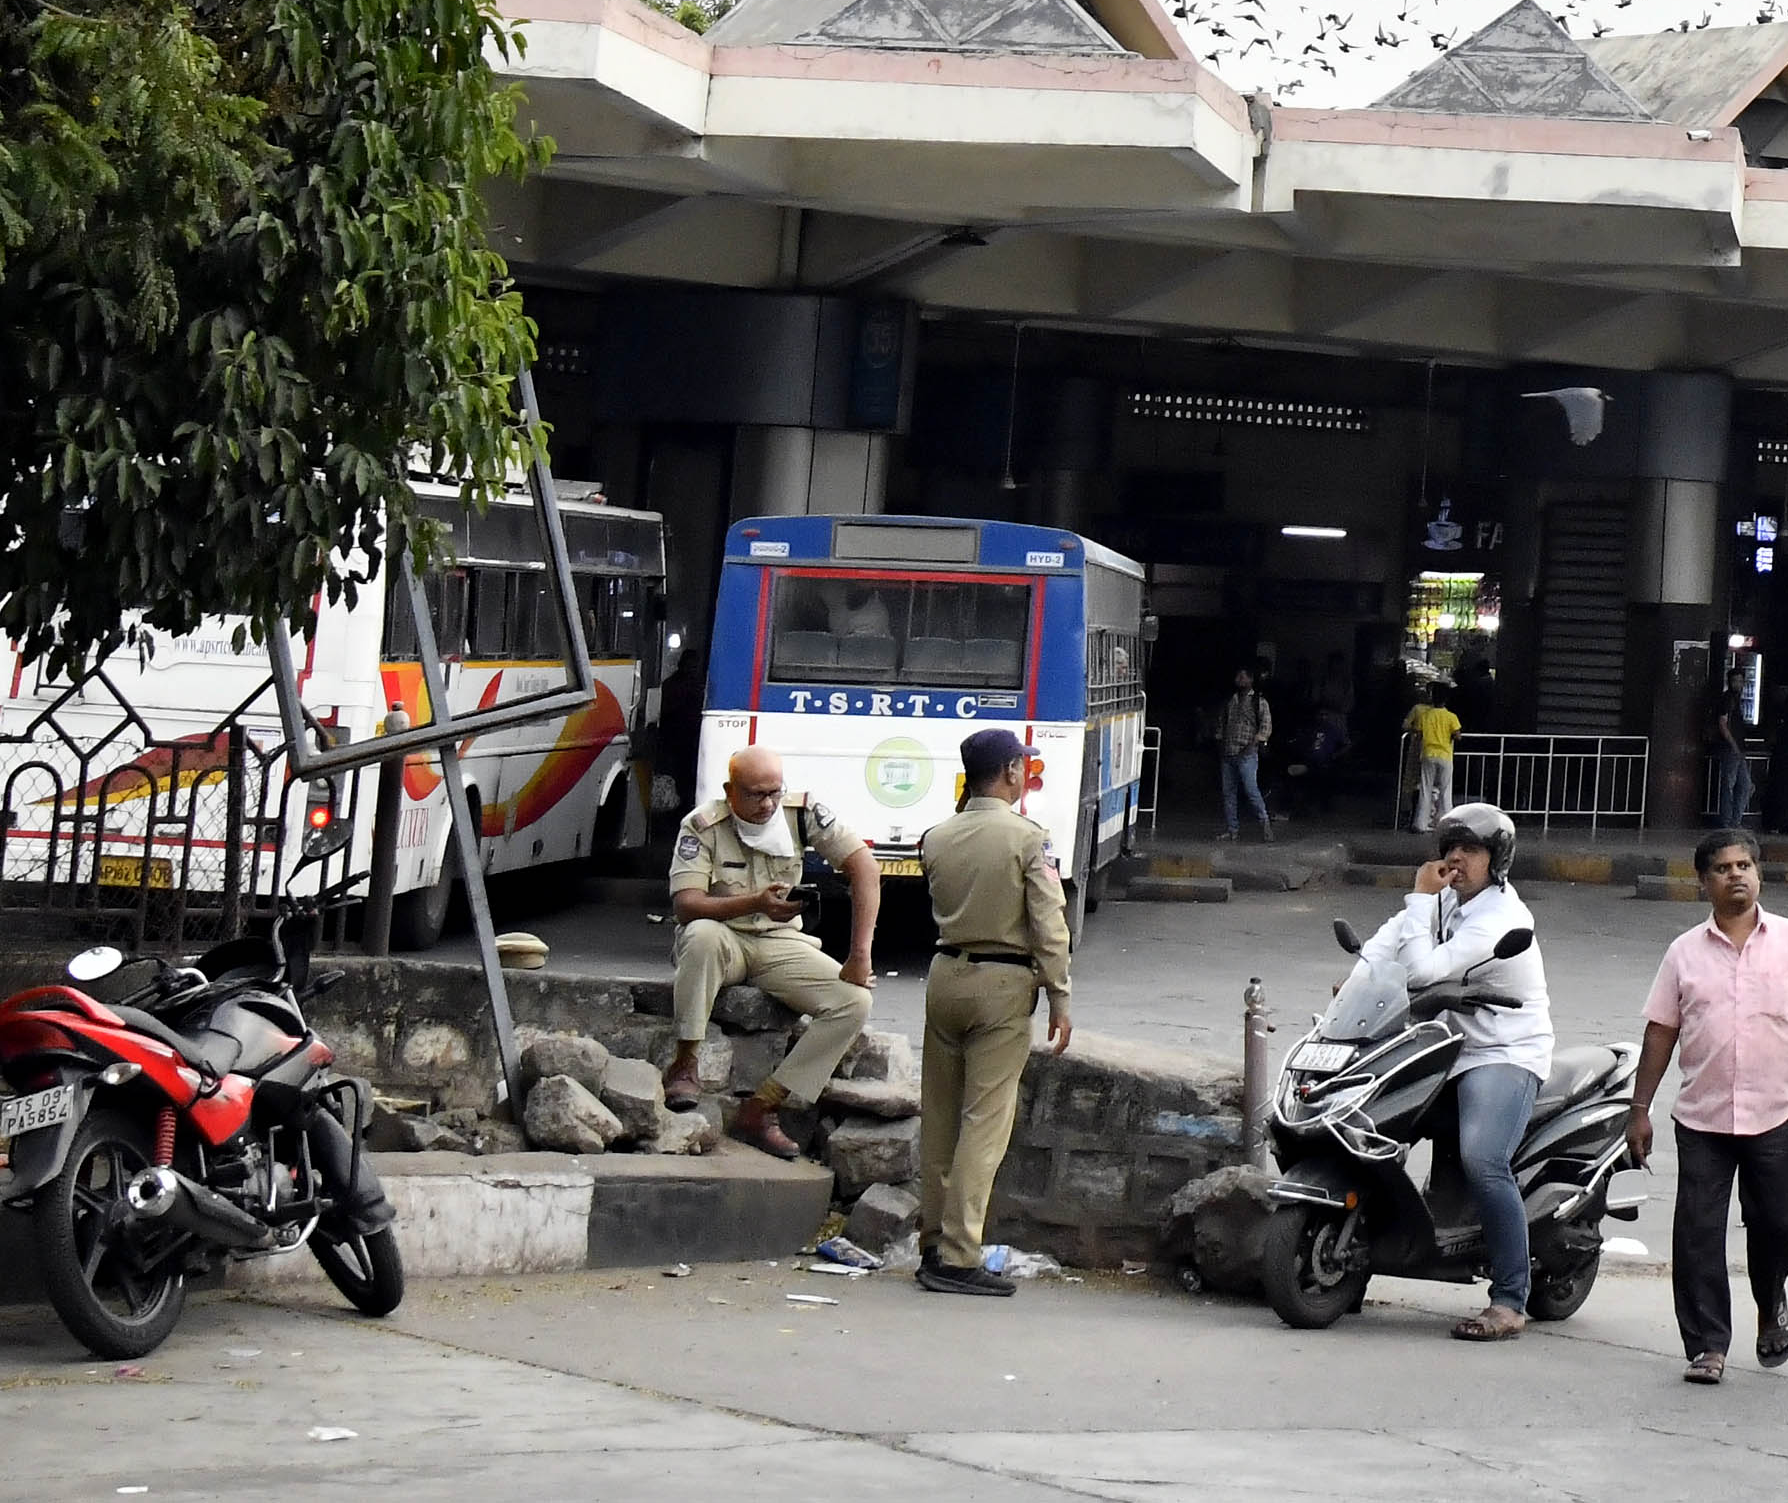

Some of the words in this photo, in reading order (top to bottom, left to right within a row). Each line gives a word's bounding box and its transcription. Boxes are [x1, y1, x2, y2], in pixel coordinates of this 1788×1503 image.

[1029, 554, 1062, 565] HYD-2
[718, 719, 748, 729] STOP
[16, 1098, 33, 1115] TS
[42, 1089, 61, 1107] 09
[8, 1103, 68, 1134] PA5854
